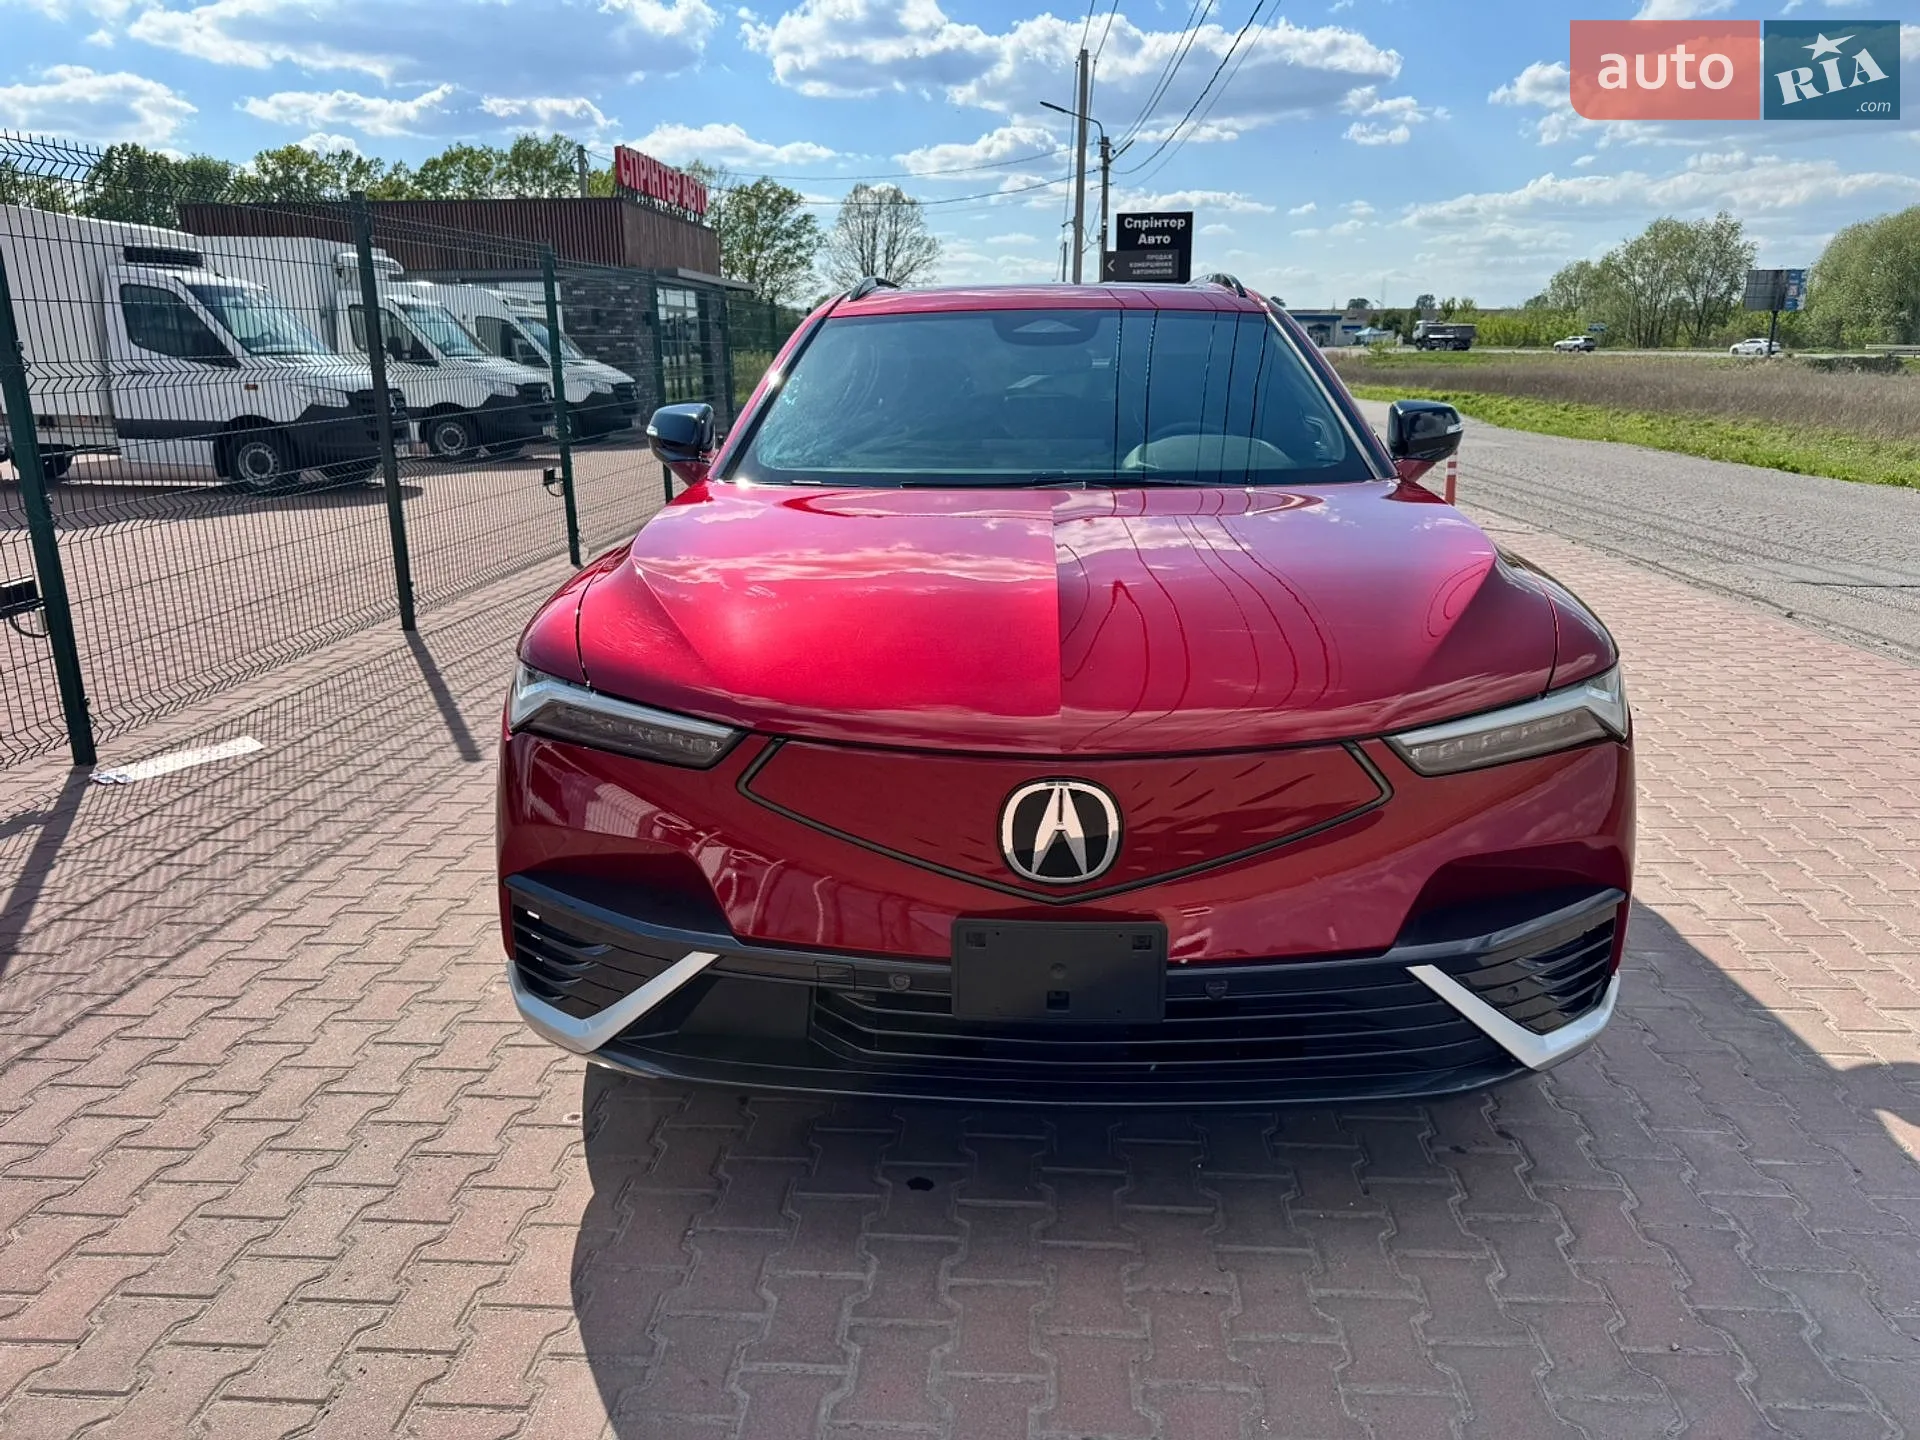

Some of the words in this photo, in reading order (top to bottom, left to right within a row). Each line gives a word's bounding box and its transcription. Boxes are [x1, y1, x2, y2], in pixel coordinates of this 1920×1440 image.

[620, 148, 681, 205] СПРІНТЕР
[683, 175, 709, 214] АВТО
[1137, 233, 1171, 245] Авто
